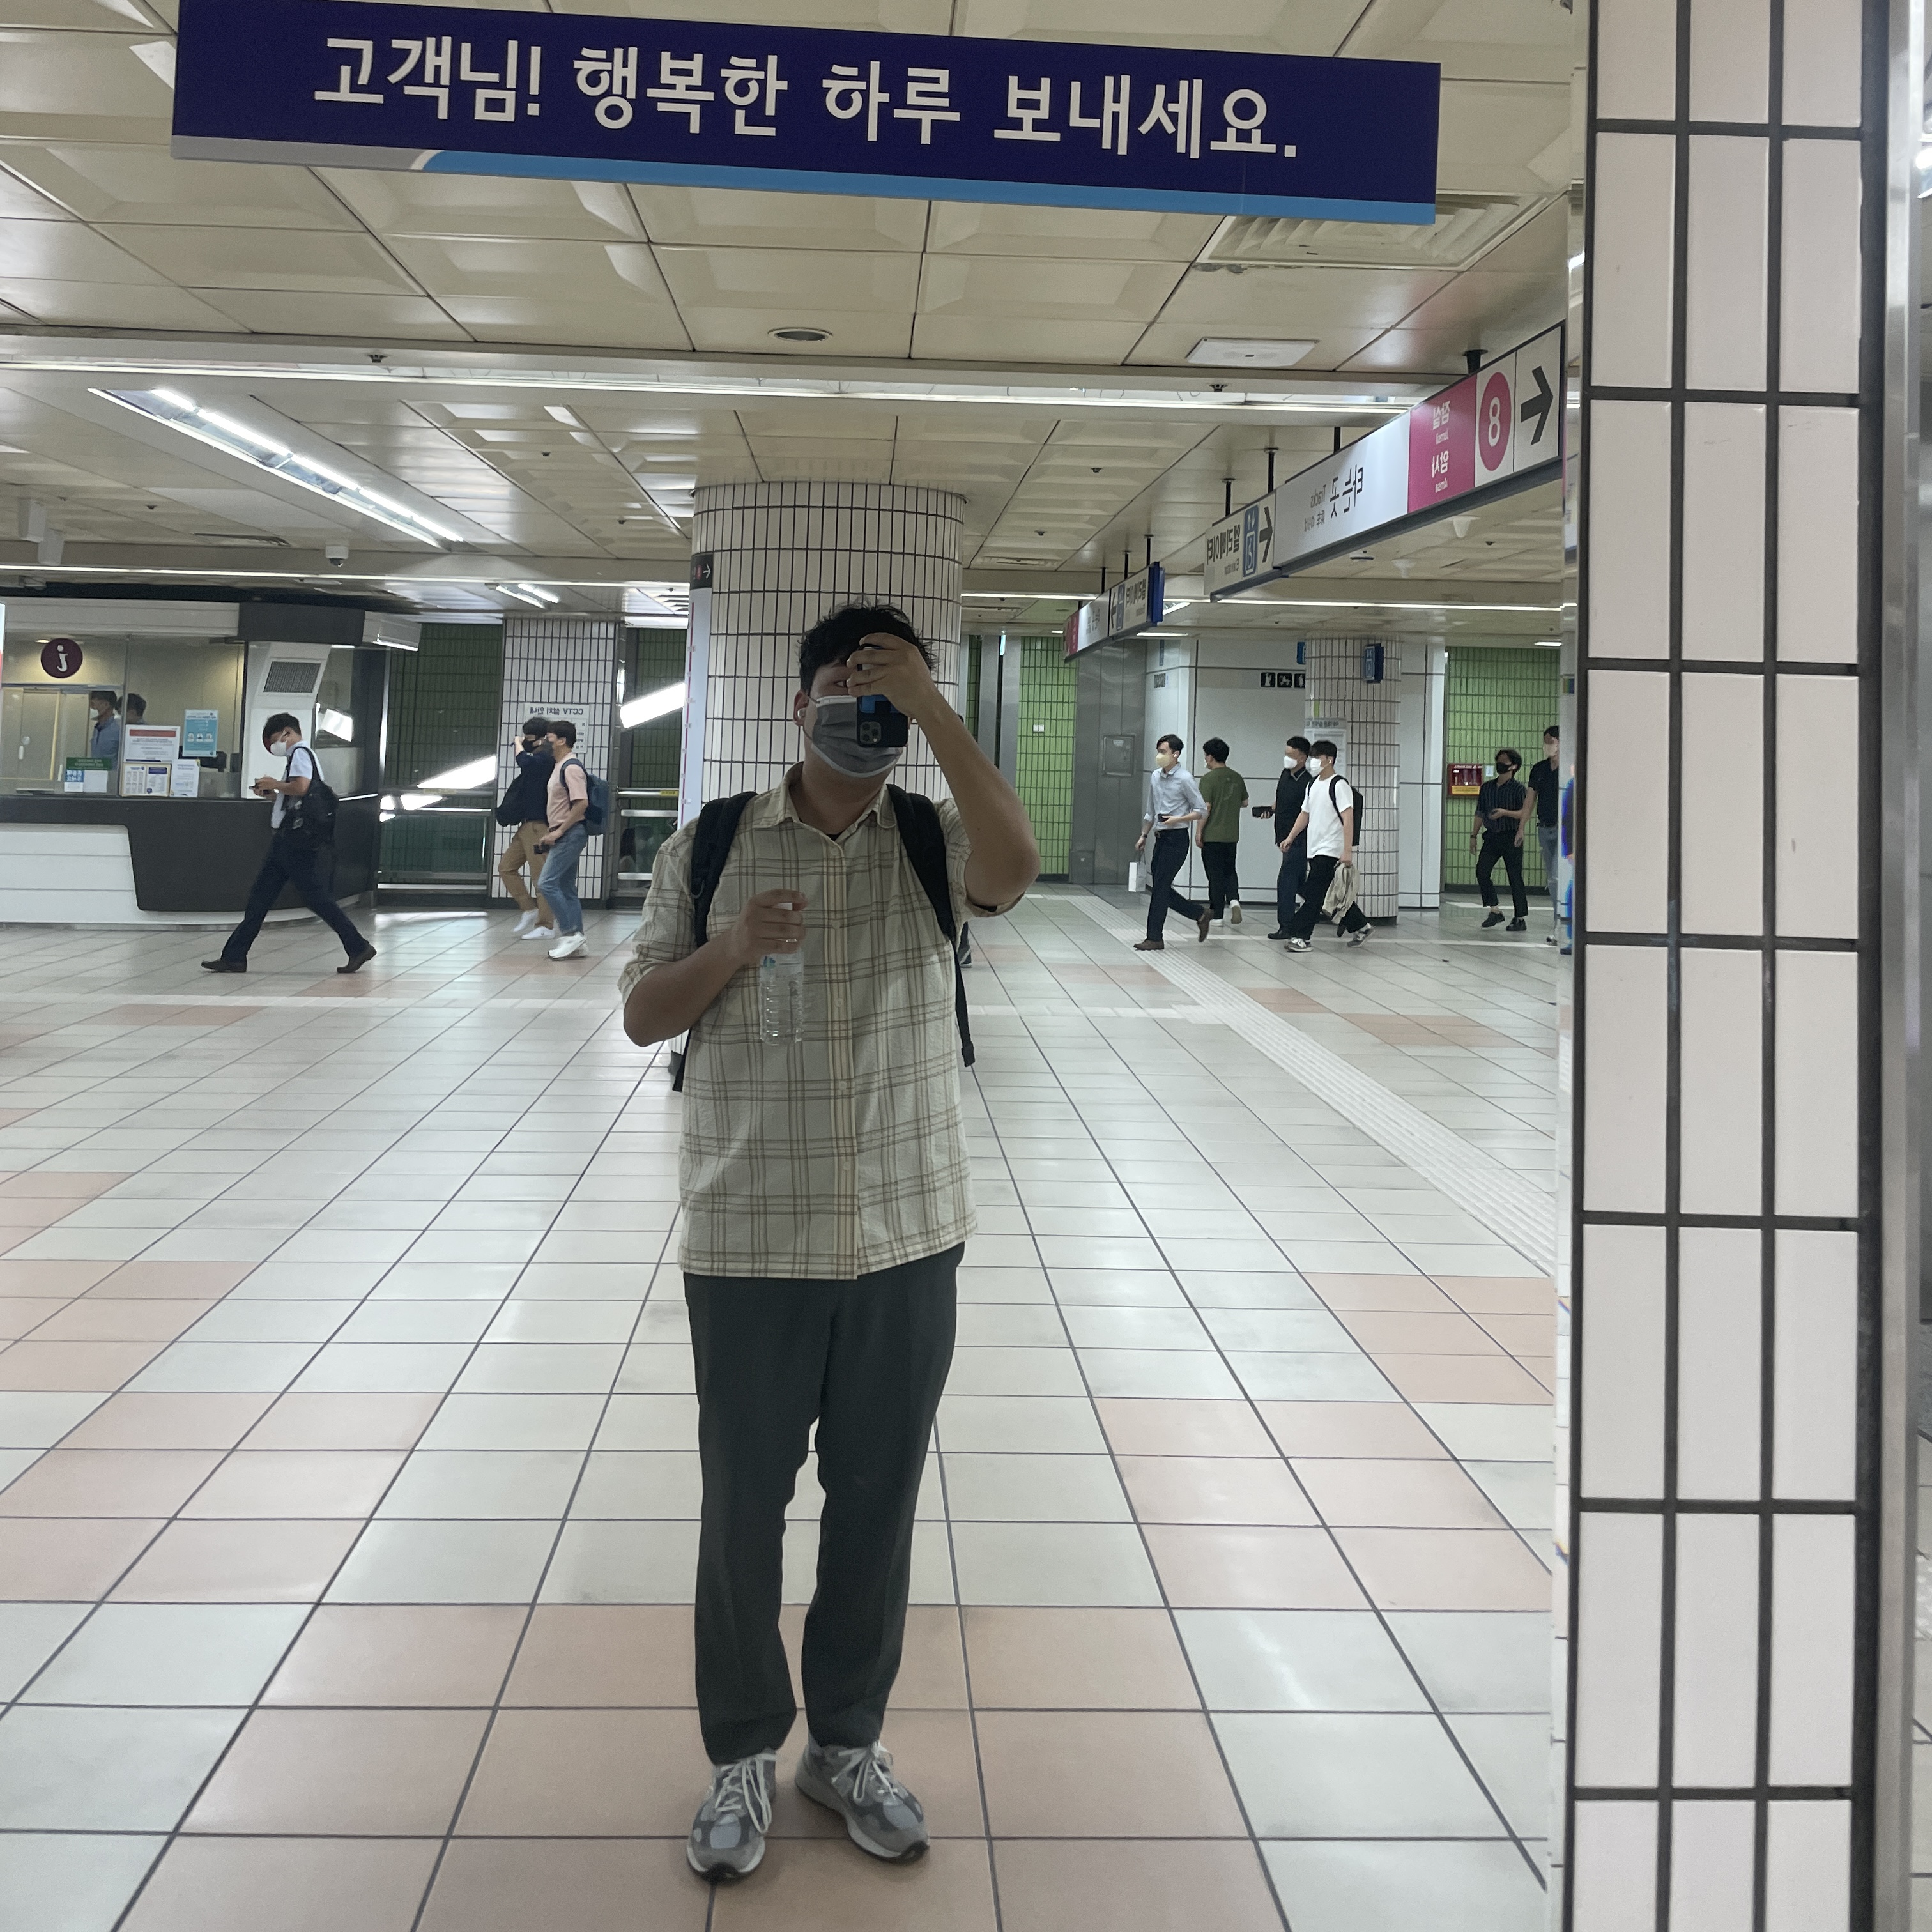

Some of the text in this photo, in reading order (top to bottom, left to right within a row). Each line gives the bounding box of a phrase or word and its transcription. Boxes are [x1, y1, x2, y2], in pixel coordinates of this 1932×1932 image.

[315, 36, 1297, 159] 고객님! 행복한 하루 보내세요.
